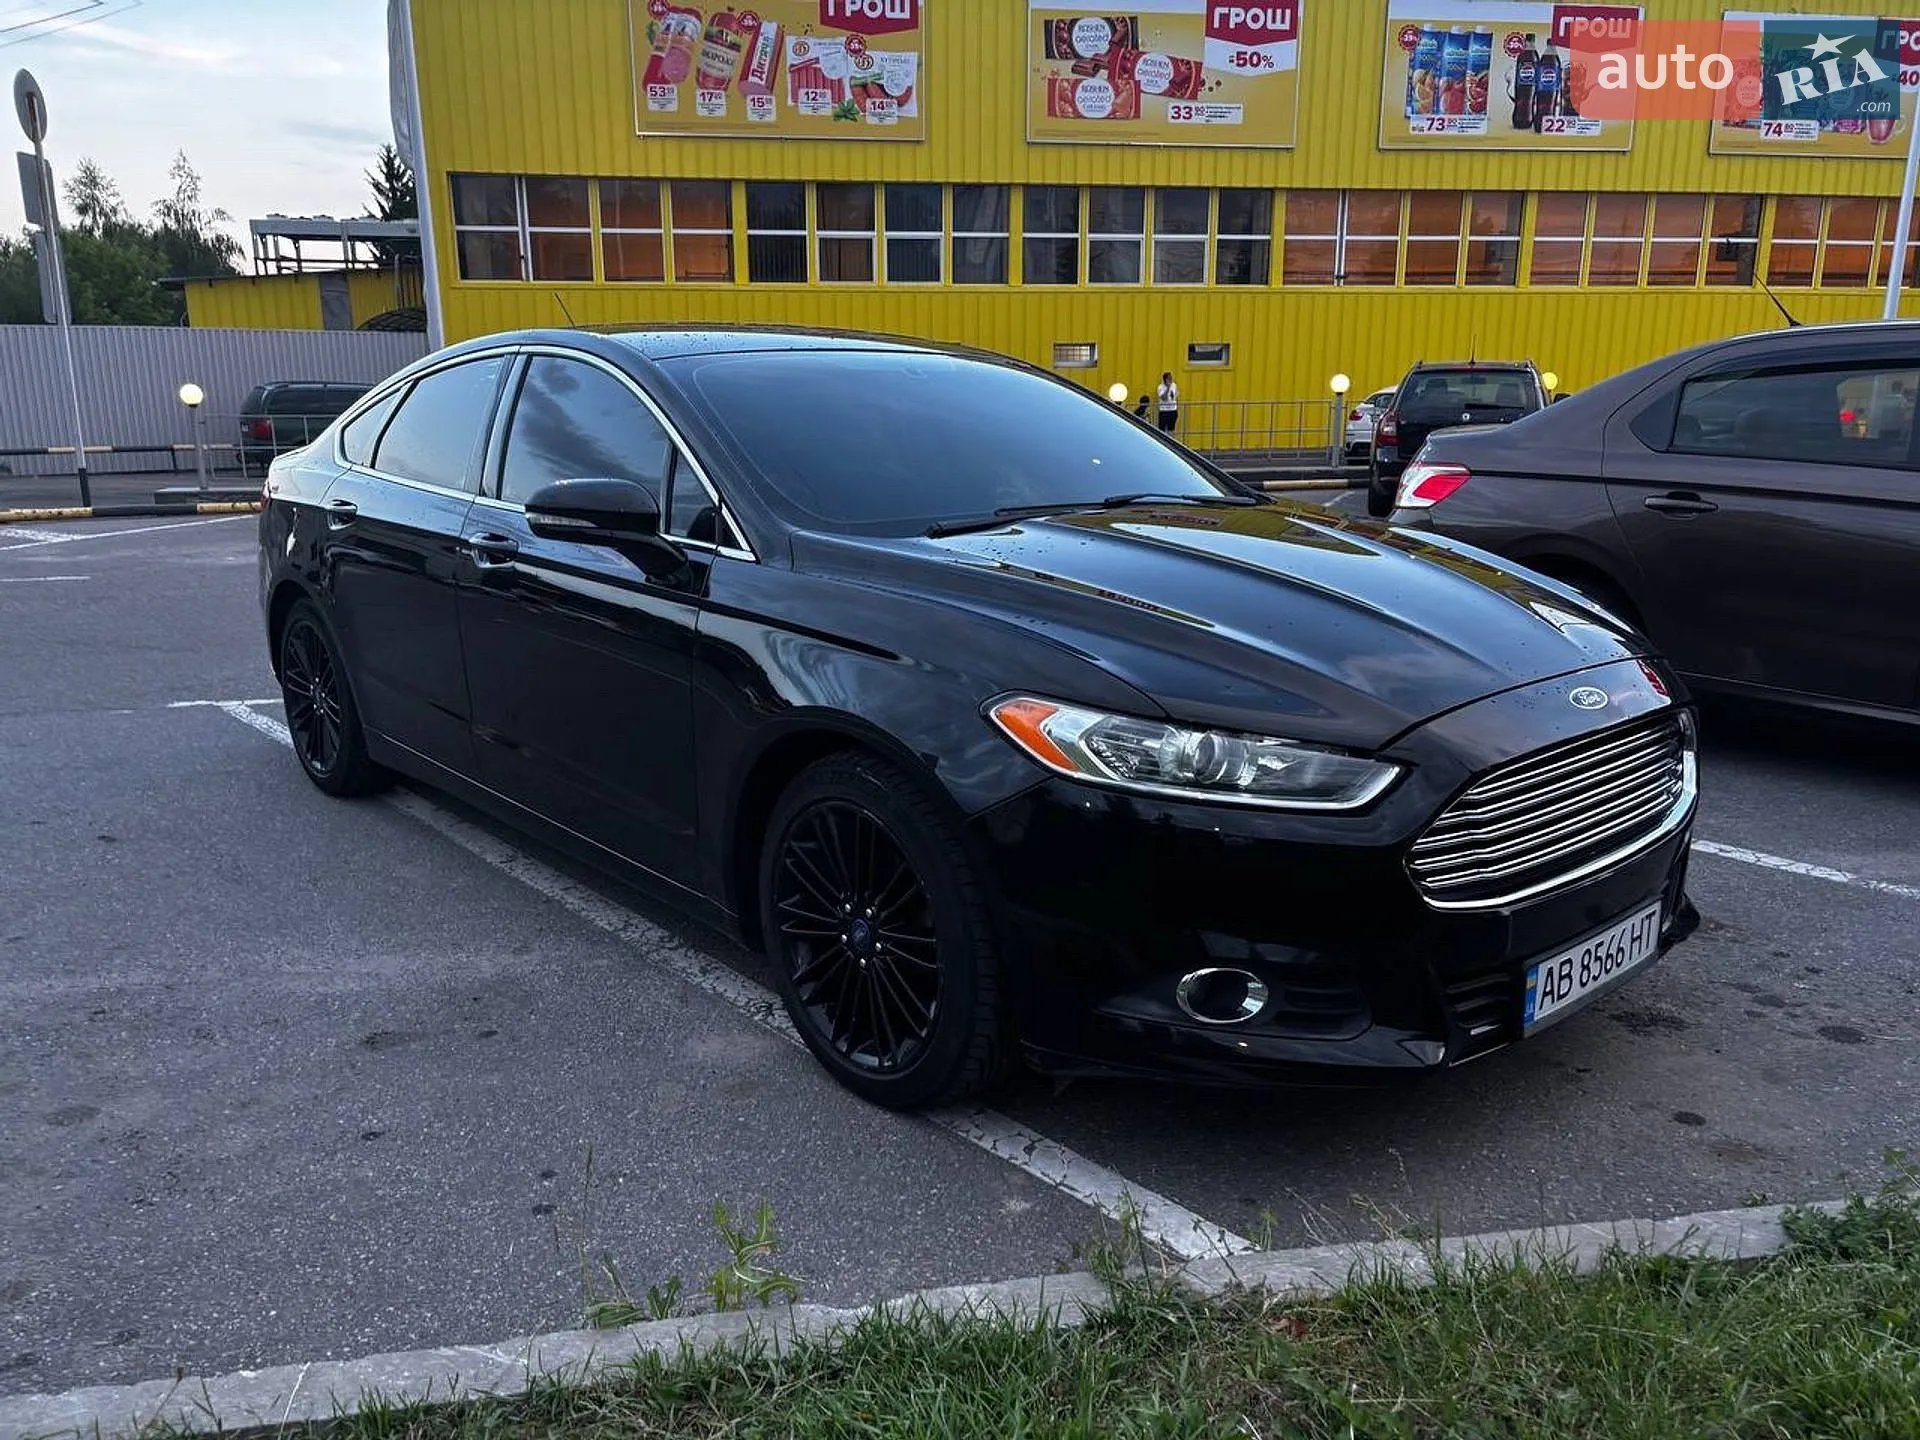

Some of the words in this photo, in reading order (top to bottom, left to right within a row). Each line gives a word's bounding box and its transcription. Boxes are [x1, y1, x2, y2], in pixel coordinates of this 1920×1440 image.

[827, 0, 911, 19] ГРОШ
[1213, 7, 1292, 30] ГРОШ
[1559, 16, 1633, 39] ГРОШ
[649, 86, 666, 97] 53
[700, 92, 714, 102] 17
[804, 91, 819, 101] 12
[750, 97, 765, 108] 15
[871, 100, 886, 111] 14
[1171, 105, 1193, 120] 33
[1426, 117, 1445, 132] 73
[1544, 119, 1566, 133] 22
[1764, 122, 1784, 137] 74
[1539, 957, 1573, 1010] AB
[1579, 928, 1626, 988] 8566
[1629, 909, 1657, 961] HT
